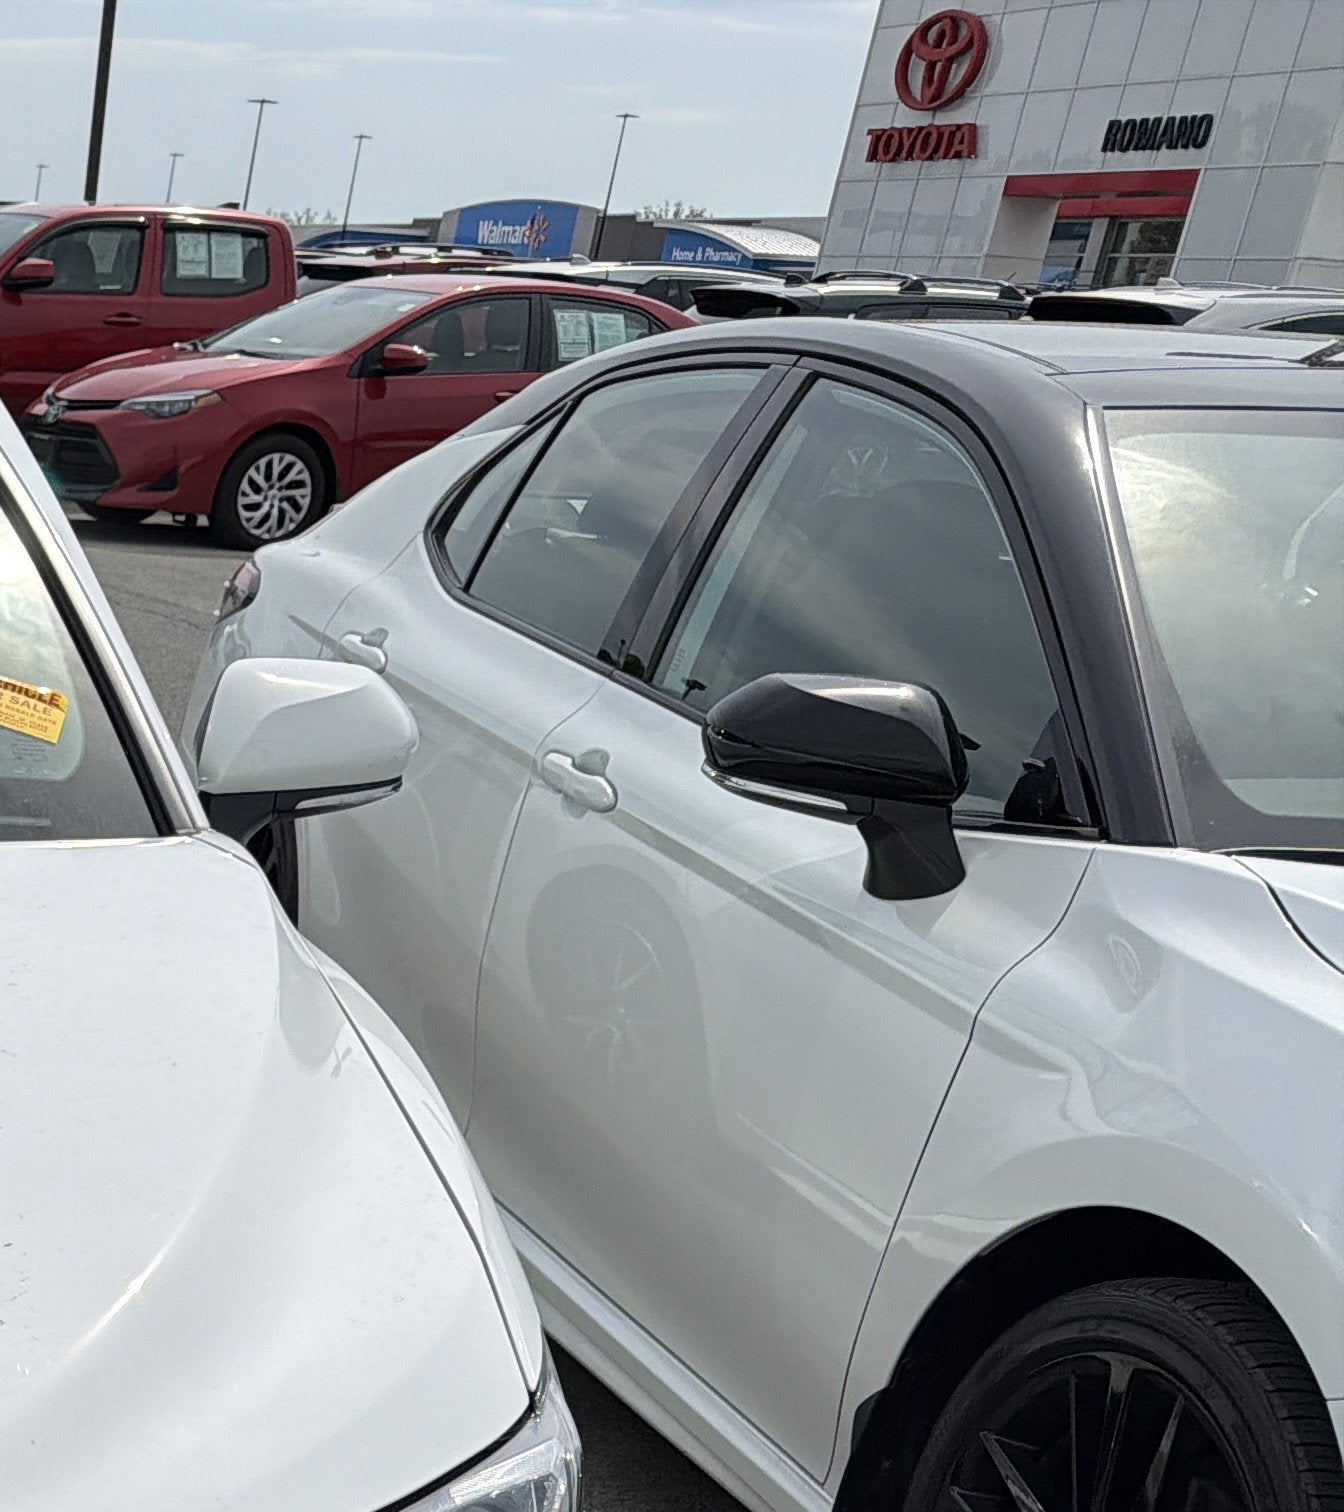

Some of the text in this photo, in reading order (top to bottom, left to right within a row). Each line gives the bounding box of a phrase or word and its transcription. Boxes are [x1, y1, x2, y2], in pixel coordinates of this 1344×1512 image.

[865, 122, 978, 163] TOYOTA
[1101, 113, 1214, 153] ROMANO
[672, 246, 695, 262] Home
[9, 695, 54, 717] SALE
